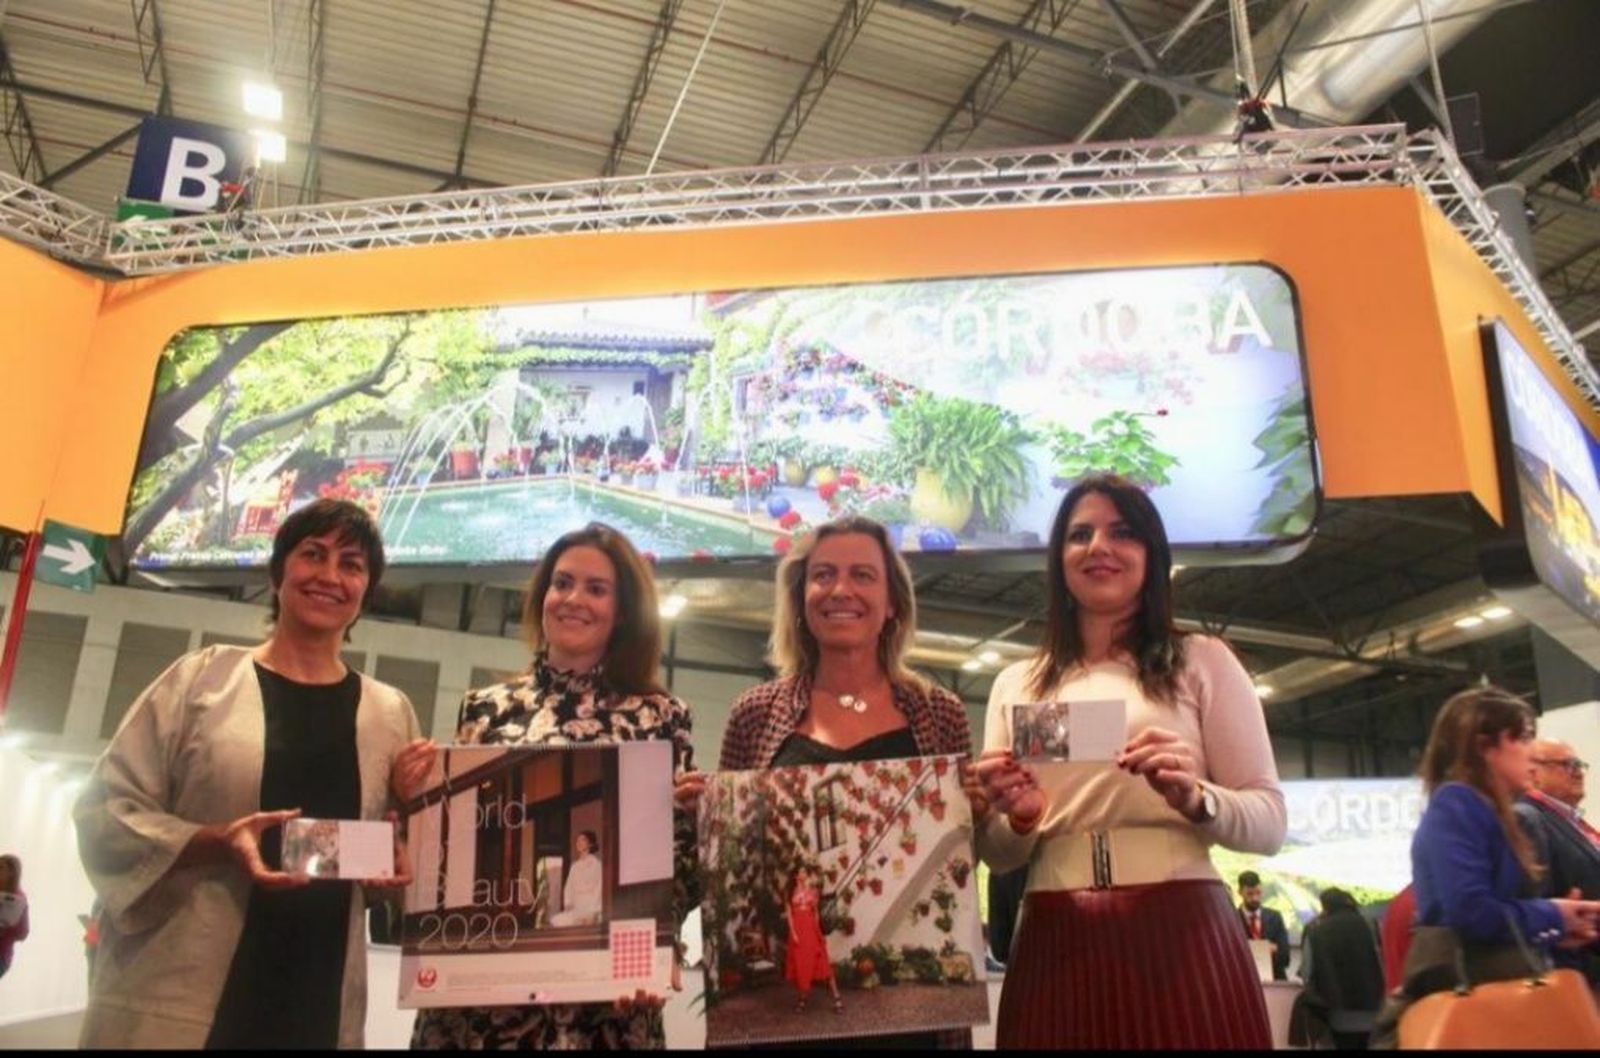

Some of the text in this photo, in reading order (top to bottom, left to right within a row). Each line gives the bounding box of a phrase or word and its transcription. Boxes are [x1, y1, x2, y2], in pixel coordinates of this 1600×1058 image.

[160, 136, 226, 213] B
[422, 791, 528, 830] orld
[418, 911, 519, 950] 2020
